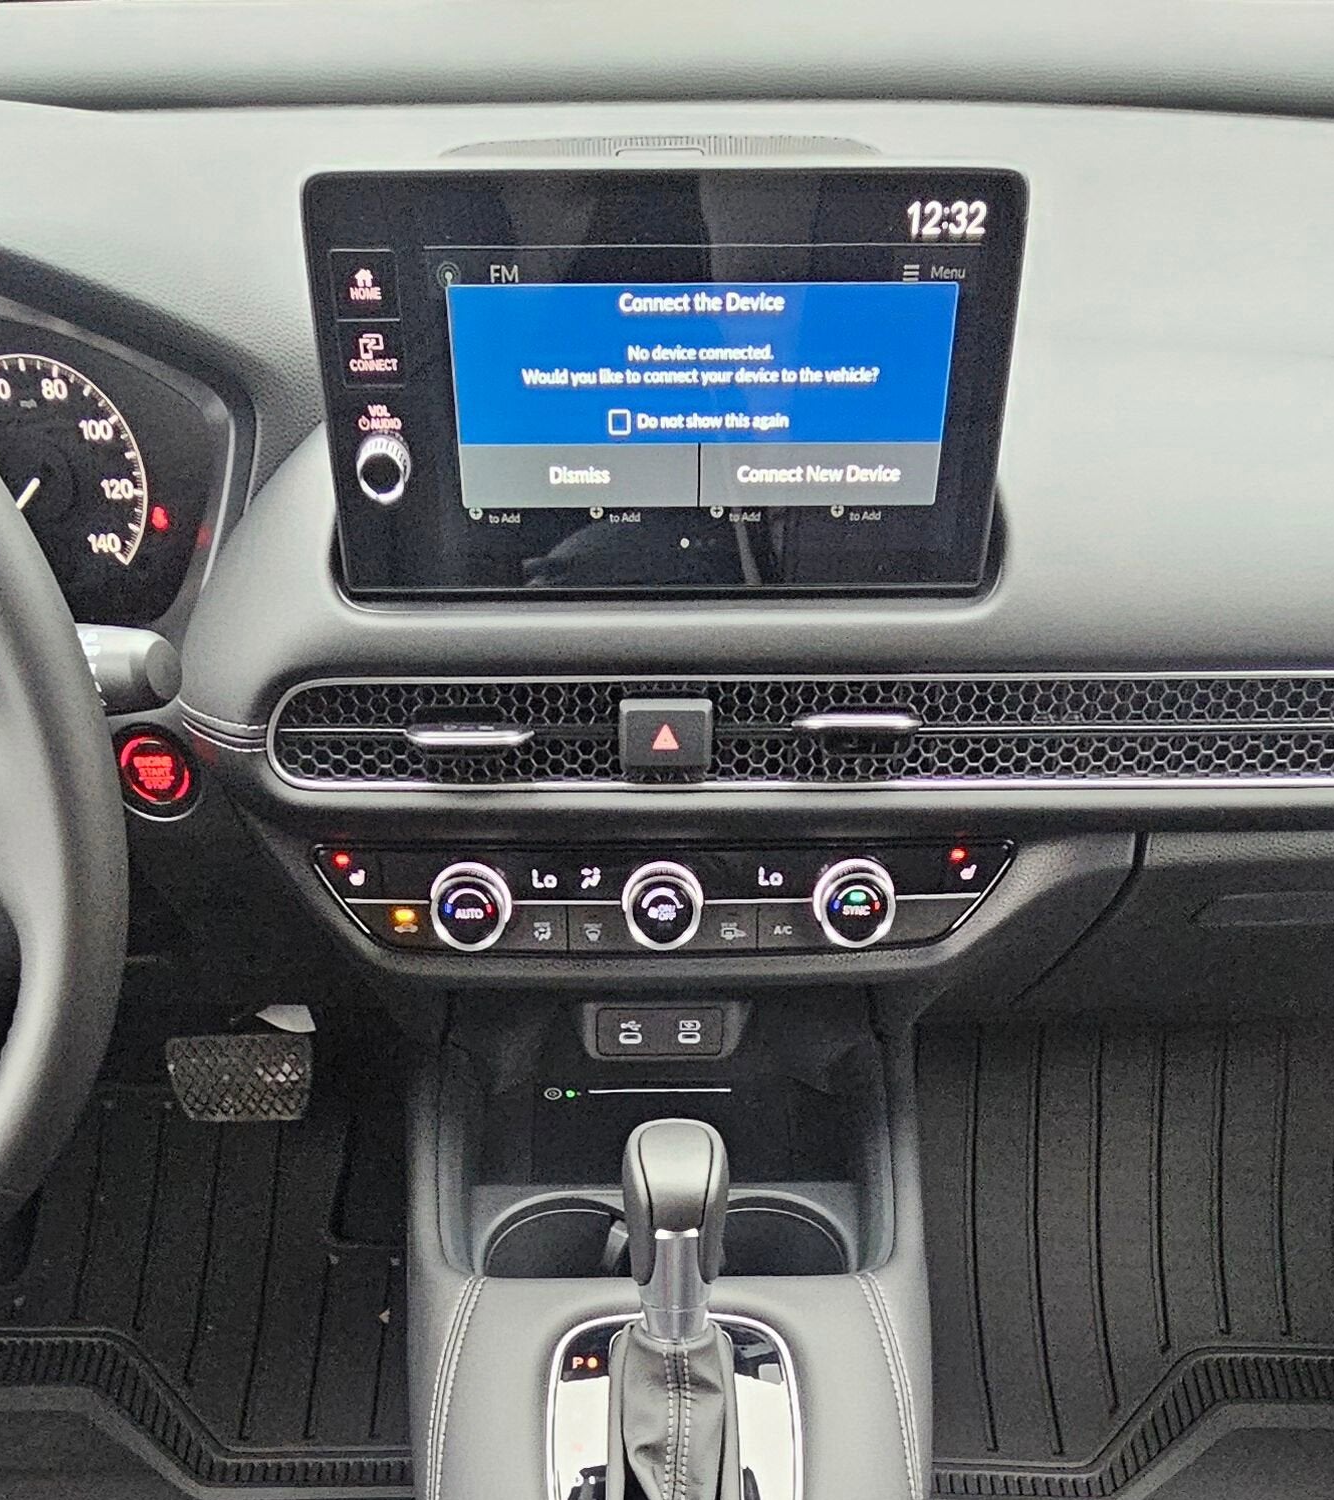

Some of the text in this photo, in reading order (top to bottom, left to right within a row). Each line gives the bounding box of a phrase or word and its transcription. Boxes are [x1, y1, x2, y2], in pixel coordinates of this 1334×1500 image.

[907, 200, 987, 235] 12:32
[490, 265, 519, 283] FM
[930, 265, 966, 279] Menu
[350, 288, 382, 300] HOME
[619, 292, 785, 313] Connect the Device
[627, 345, 774, 361] No device connected.
[350, 359, 398, 372] CONNECT
[522, 366, 881, 388] Would you like to connect your device to the vehicle?
[41, 378, 68, 400] 80
[368, 404, 390, 417] VOL
[371, 418, 402, 430] AUDIO
[637, 413, 790, 432] Do not show this again
[78, 420, 114, 441] 100
[549, 466, 611, 485] Dismiss
[737, 464, 901, 484] Connect New Device
[100, 478, 135, 500] 120
[489, 513, 521, 525] to Add
[609, 512, 641, 524] to Add
[729, 511, 761, 523] to Add
[849, 510, 881, 522] to Add
[87, 533, 122, 553] 140
[138, 767, 172, 777] START
[531, 868, 557, 888] Lo
[757, 866, 783, 886] Lo
[455, 908, 484, 919] AUTO
[843, 905, 871, 916] SYNC
[773, 925, 793, 935] A/C
[571, 1356, 584, 1370] P
